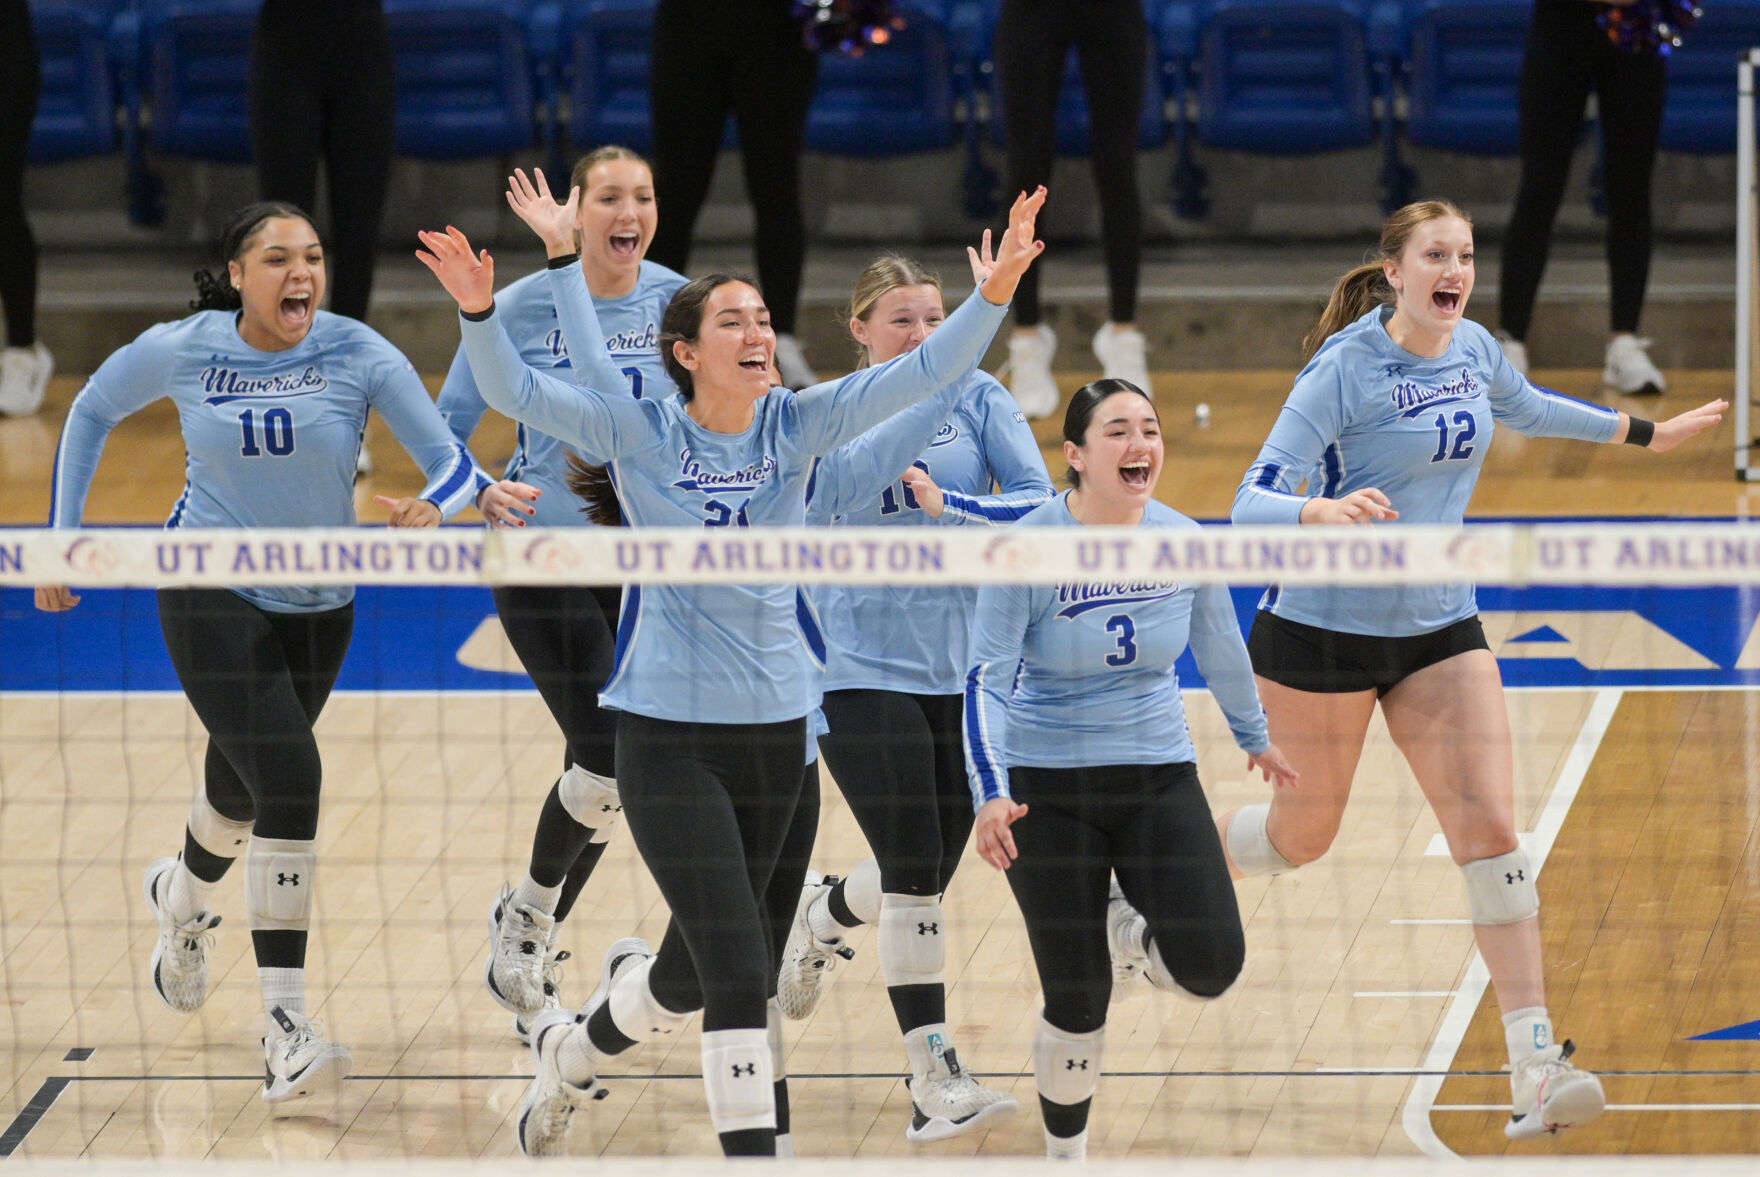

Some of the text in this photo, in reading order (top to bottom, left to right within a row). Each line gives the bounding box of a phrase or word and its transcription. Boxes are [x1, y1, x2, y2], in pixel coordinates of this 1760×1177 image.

[200, 366, 325, 396] Mavericks
[238, 408, 295, 458] 10
[1430, 410, 1477, 463] 12
[681, 447, 777, 487] Maverics
[156, 542, 484, 573] UT ARLINGTON
[616, 541, 944, 572] UT ARLINGTON
[1077, 540, 1408, 572] UT ARLINGTON
[1538, 538, 1760, 569] UT ARLIN
[1105, 613, 1138, 667] 3
